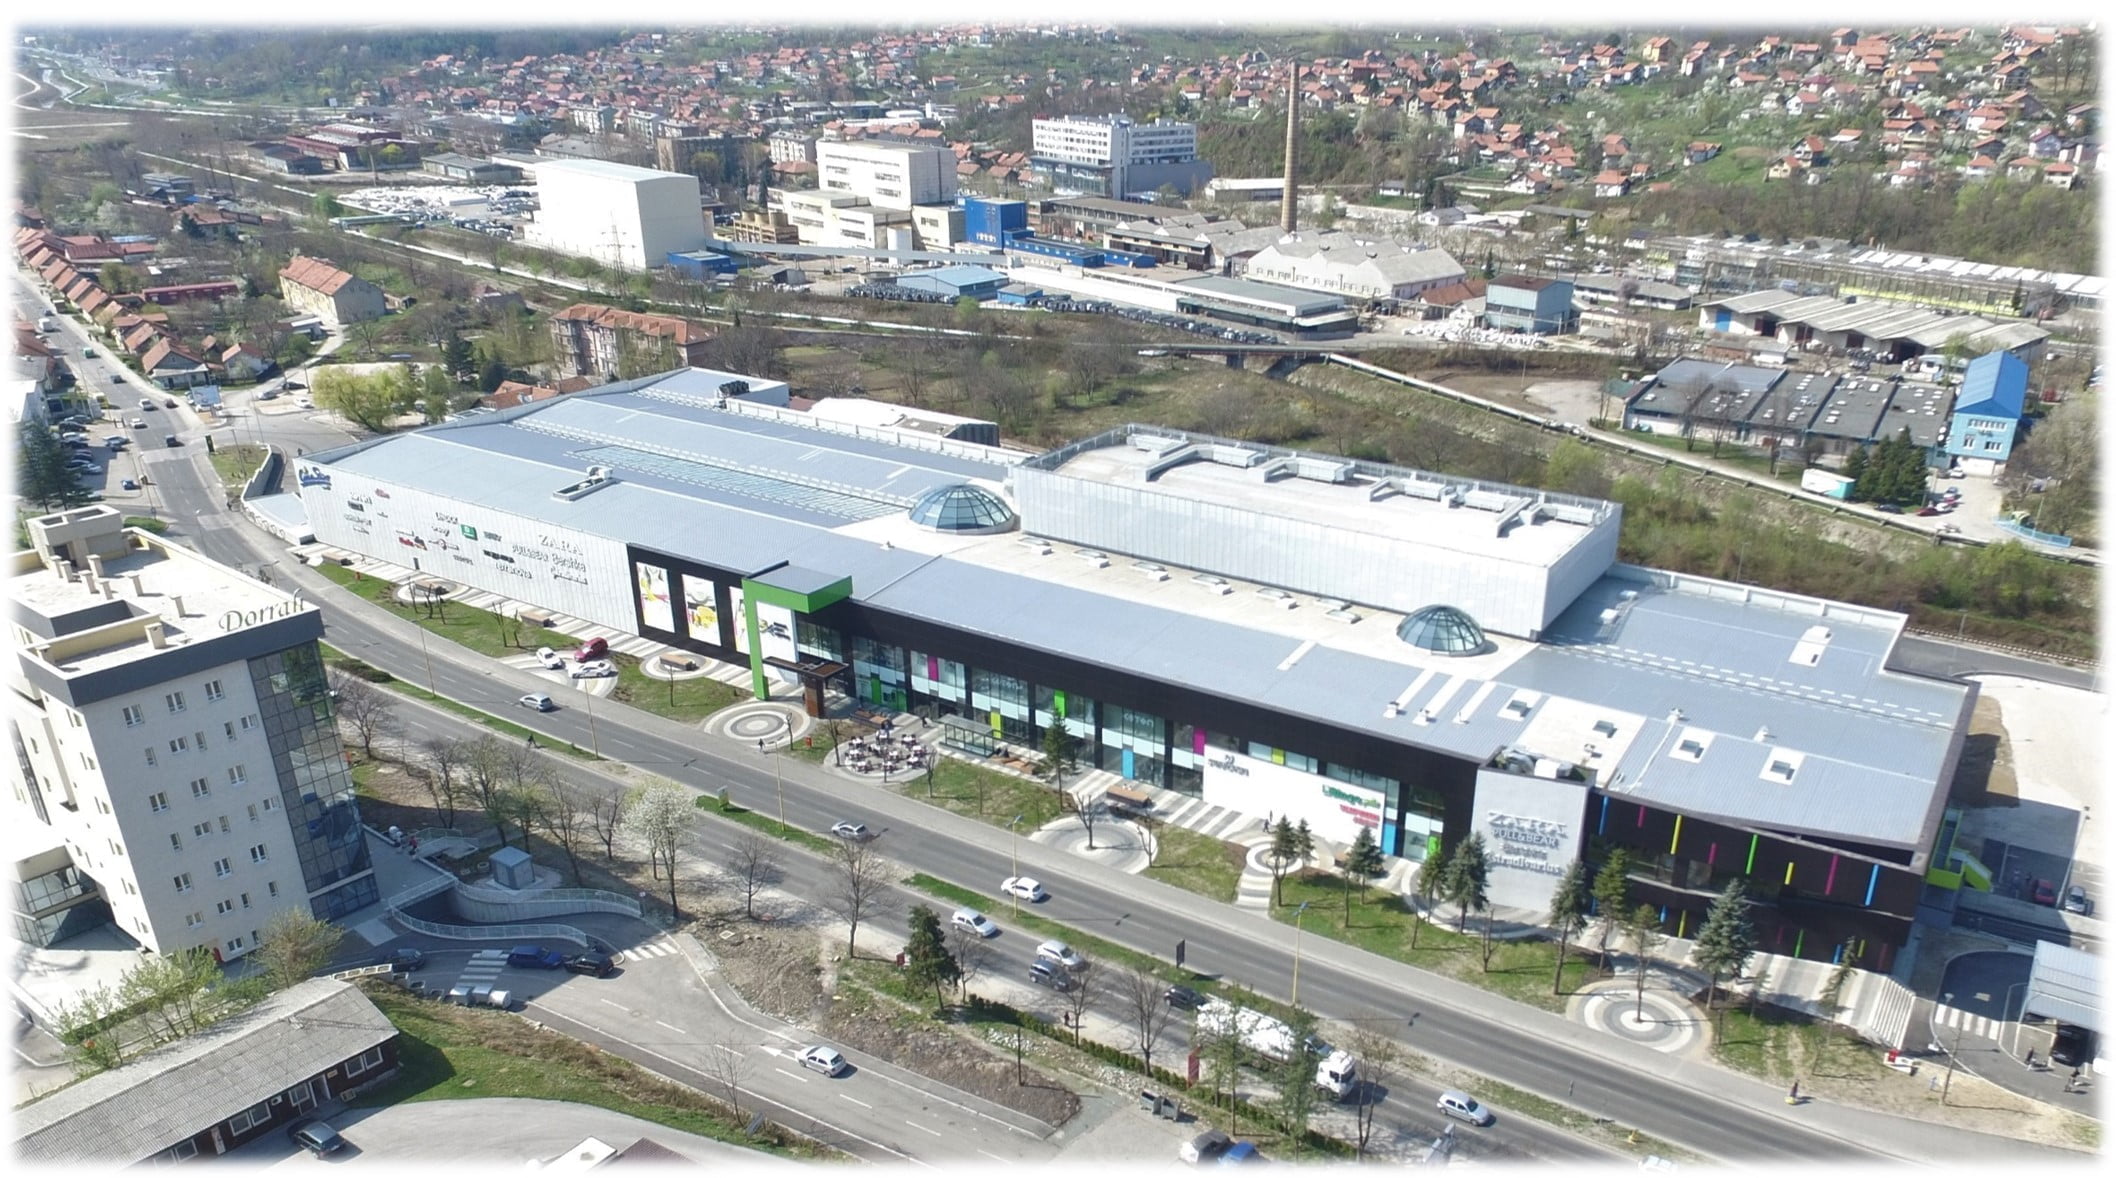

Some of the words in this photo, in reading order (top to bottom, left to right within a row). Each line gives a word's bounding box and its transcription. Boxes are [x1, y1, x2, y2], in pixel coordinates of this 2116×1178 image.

[538, 534, 584, 556] ZARA
[1486, 811, 1568, 838] ZARA
[1492, 827, 1559, 849] PULL&BEAR
